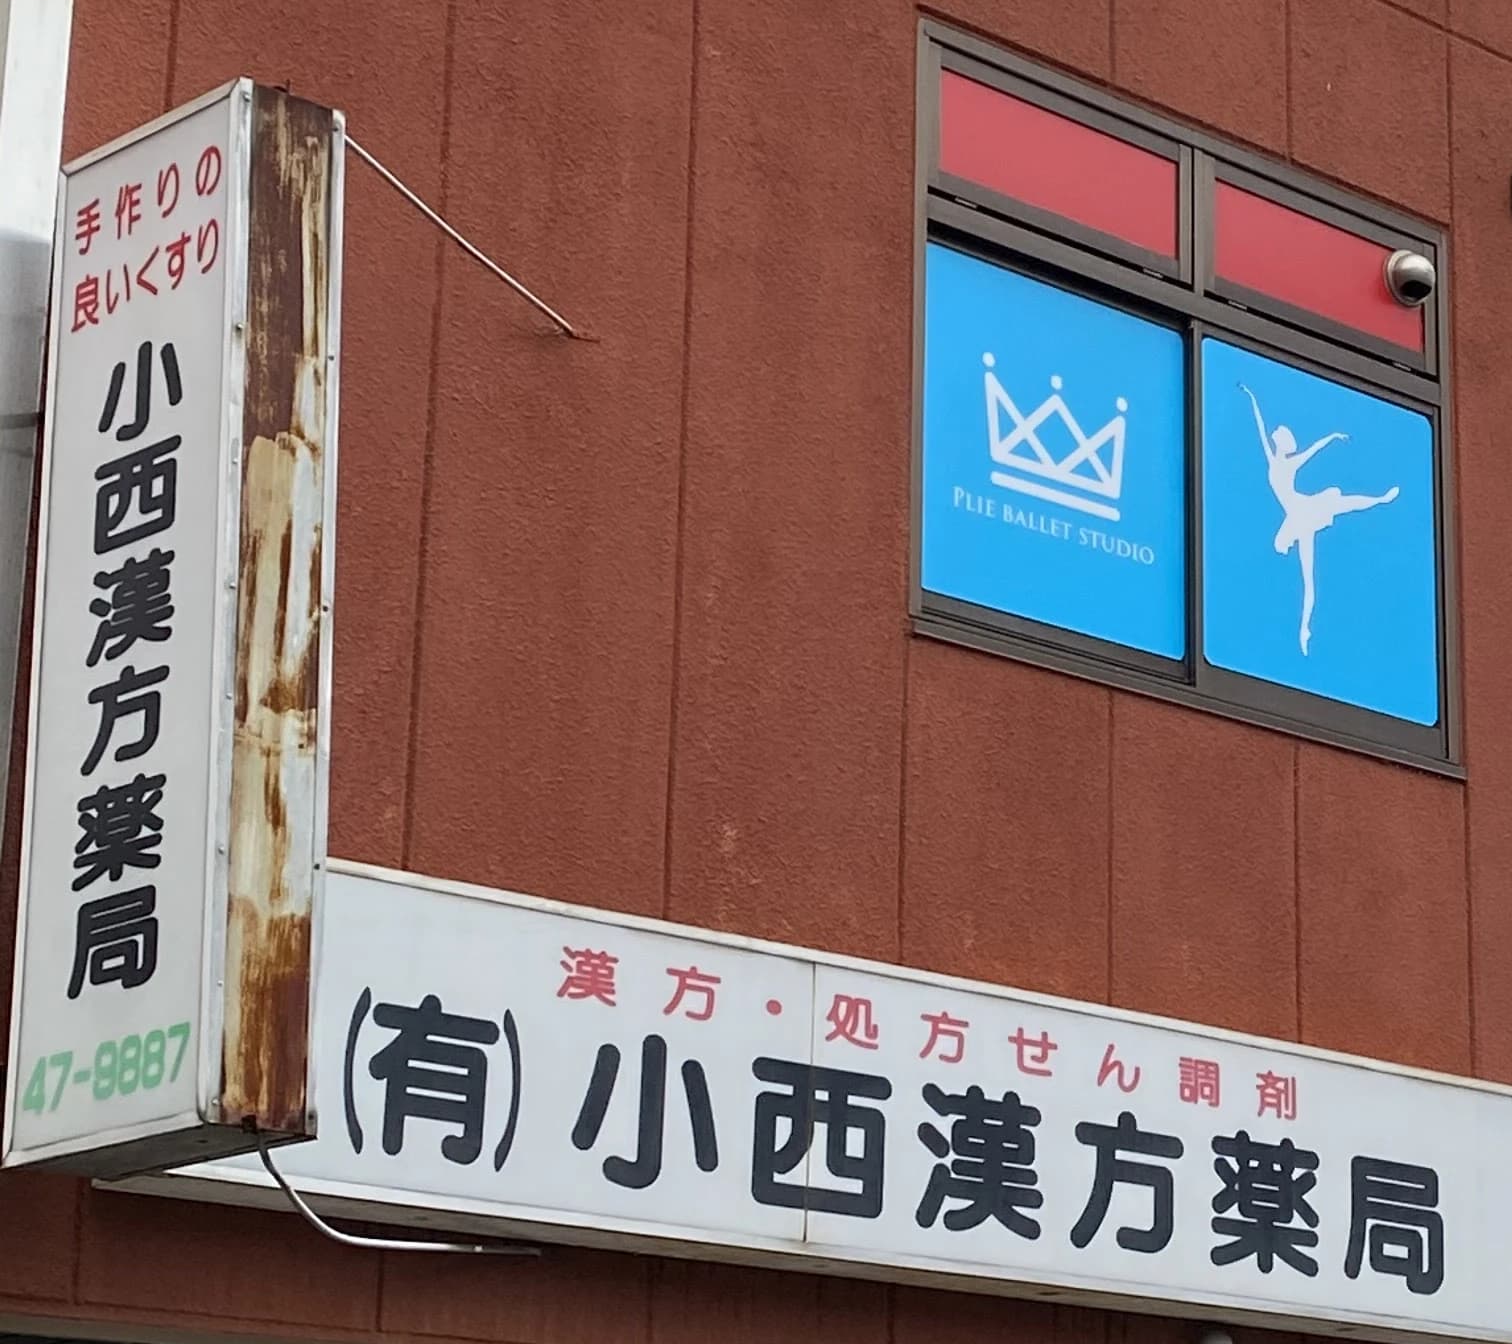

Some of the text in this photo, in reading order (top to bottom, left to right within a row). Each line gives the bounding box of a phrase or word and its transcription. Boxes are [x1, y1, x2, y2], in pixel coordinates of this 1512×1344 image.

[74, 145, 220, 256] 手作りの
[71, 217, 220, 333] 良いくすり
[1003, 503, 1071, 541] BALLET
[1079, 525, 1155, 565] STUDIO
[68, 341, 183, 1002] 小西漢方薬局
[557, 945, 1297, 1121] 漢方・処方せん調剤
